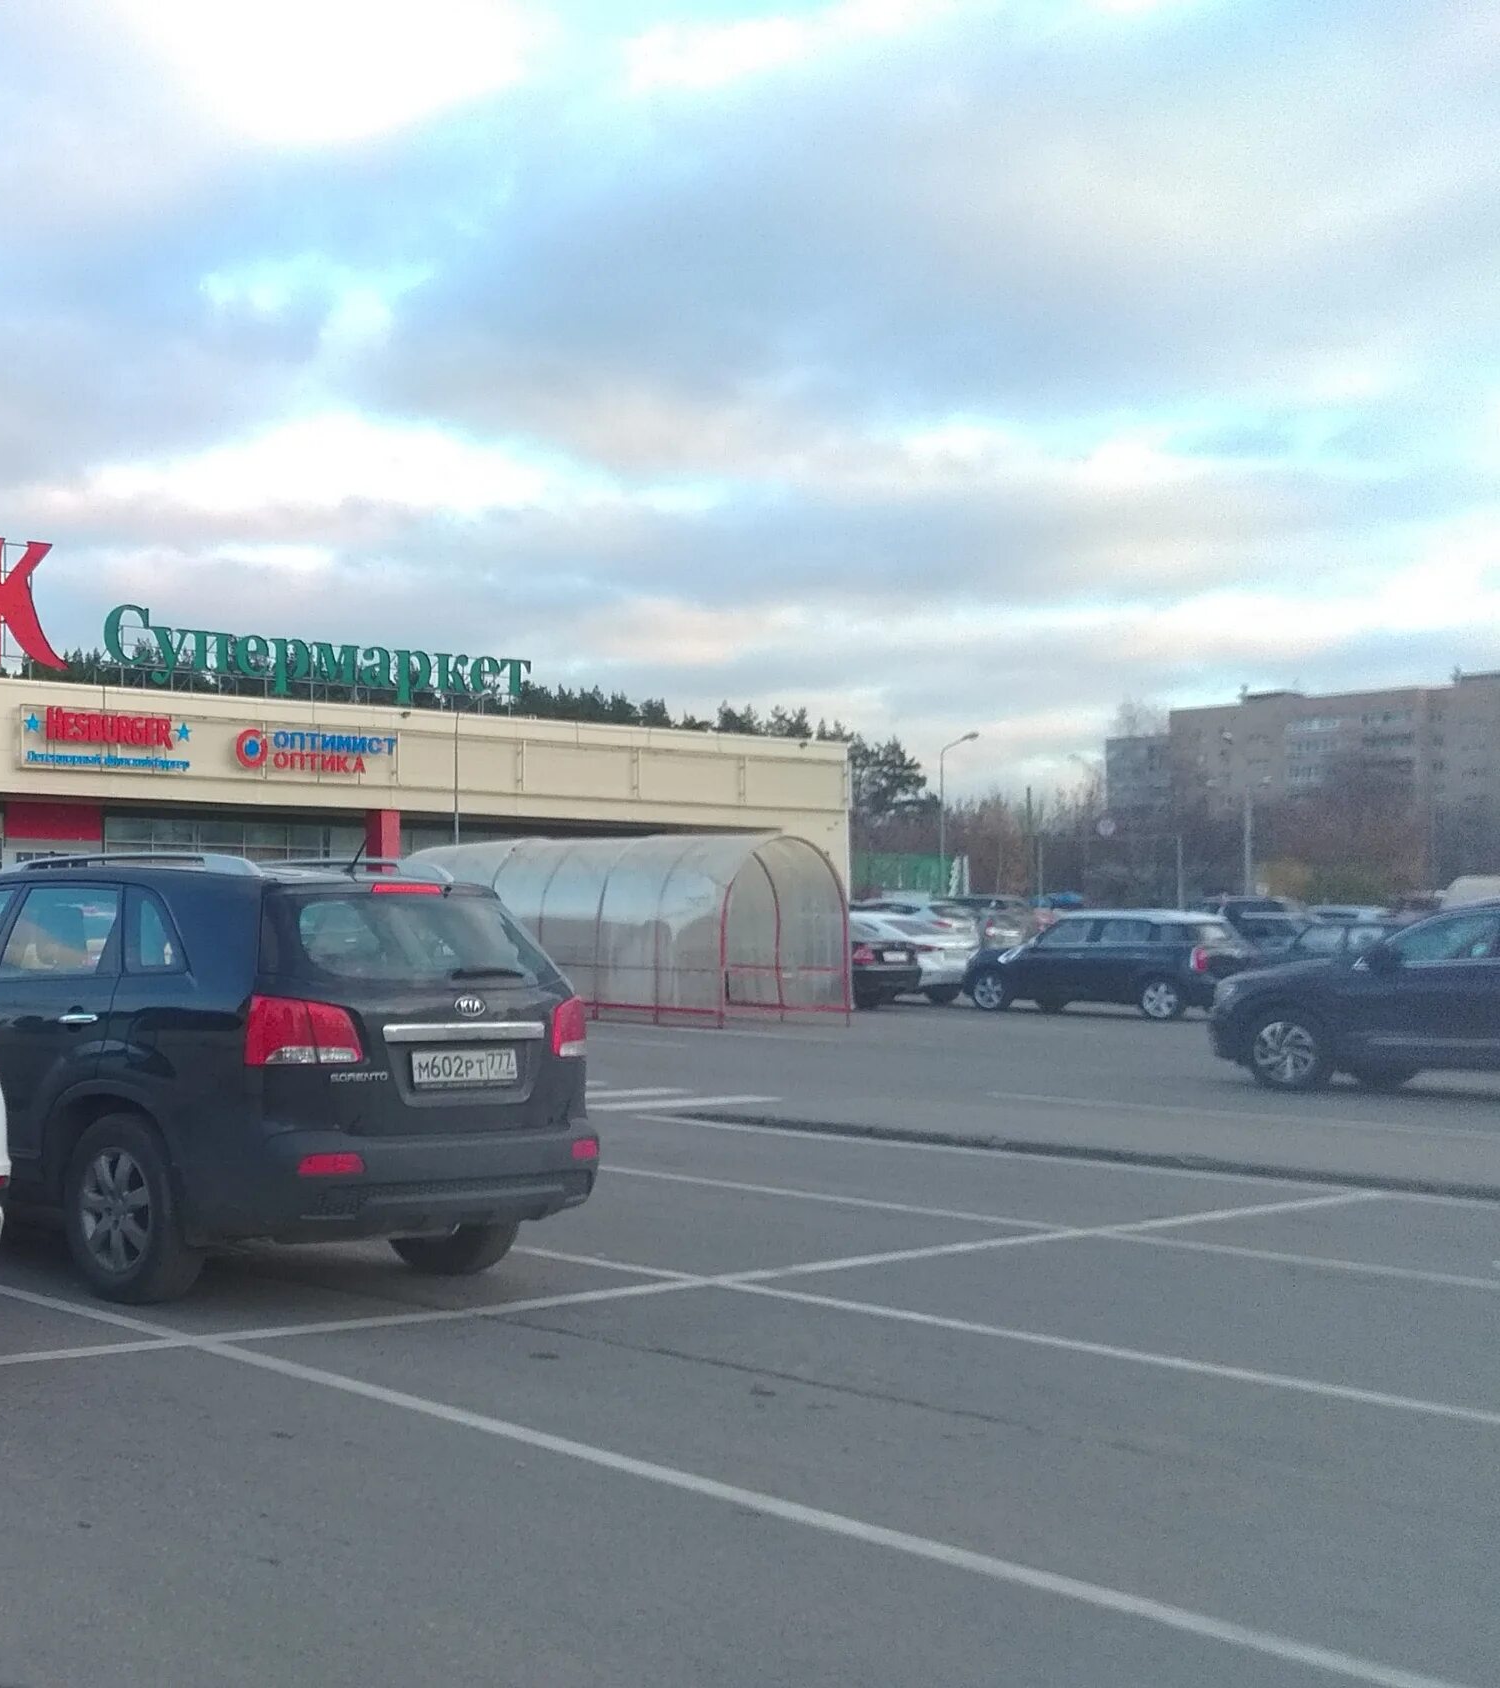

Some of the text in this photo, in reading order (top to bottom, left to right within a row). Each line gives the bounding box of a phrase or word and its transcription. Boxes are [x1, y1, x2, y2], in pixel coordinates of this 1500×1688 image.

[103, 604, 532, 705] Супермаркет
[46, 706, 173, 750] HESBURGER
[273, 731, 397, 755] ОПТИМИСТ
[273, 752, 366, 774] ОПТИКА
[460, 1000, 481, 1013] KIA
[488, 1053, 512, 1070] 777
[330, 1071, 389, 1083] SORENTO
